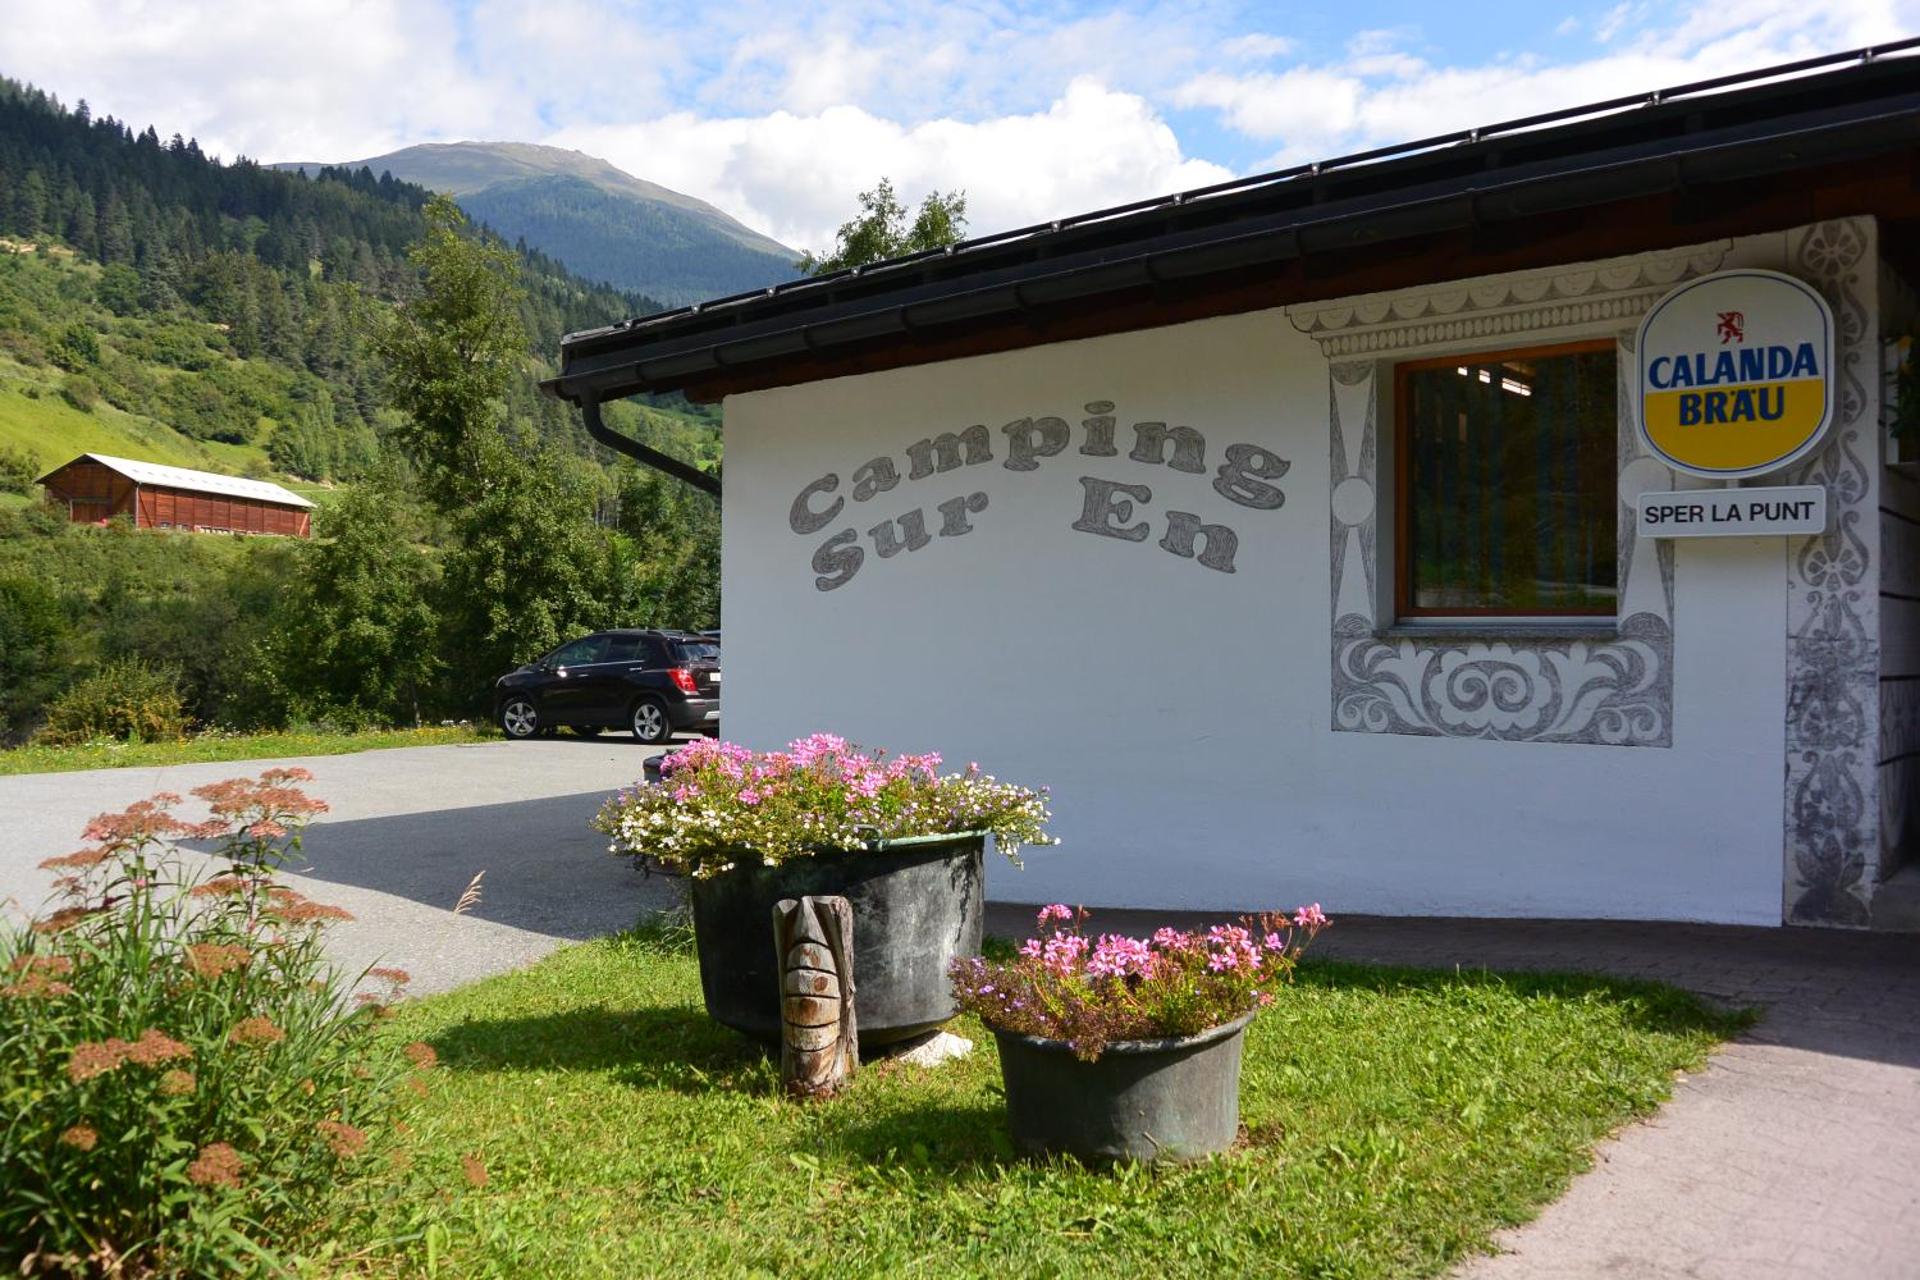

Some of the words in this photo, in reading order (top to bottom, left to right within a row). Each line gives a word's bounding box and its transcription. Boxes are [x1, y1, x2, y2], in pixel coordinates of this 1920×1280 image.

[1649, 342, 1819, 389] CALANDA
[1679, 386, 1785, 426] BRÄU
[789, 400, 1291, 535] Camping
[811, 491, 989, 592] Sur
[1071, 476, 1239, 574] En
[1645, 504, 1704, 524] SPER
[1712, 503, 1742, 522] LA
[1749, 501, 1816, 521] PUNT
